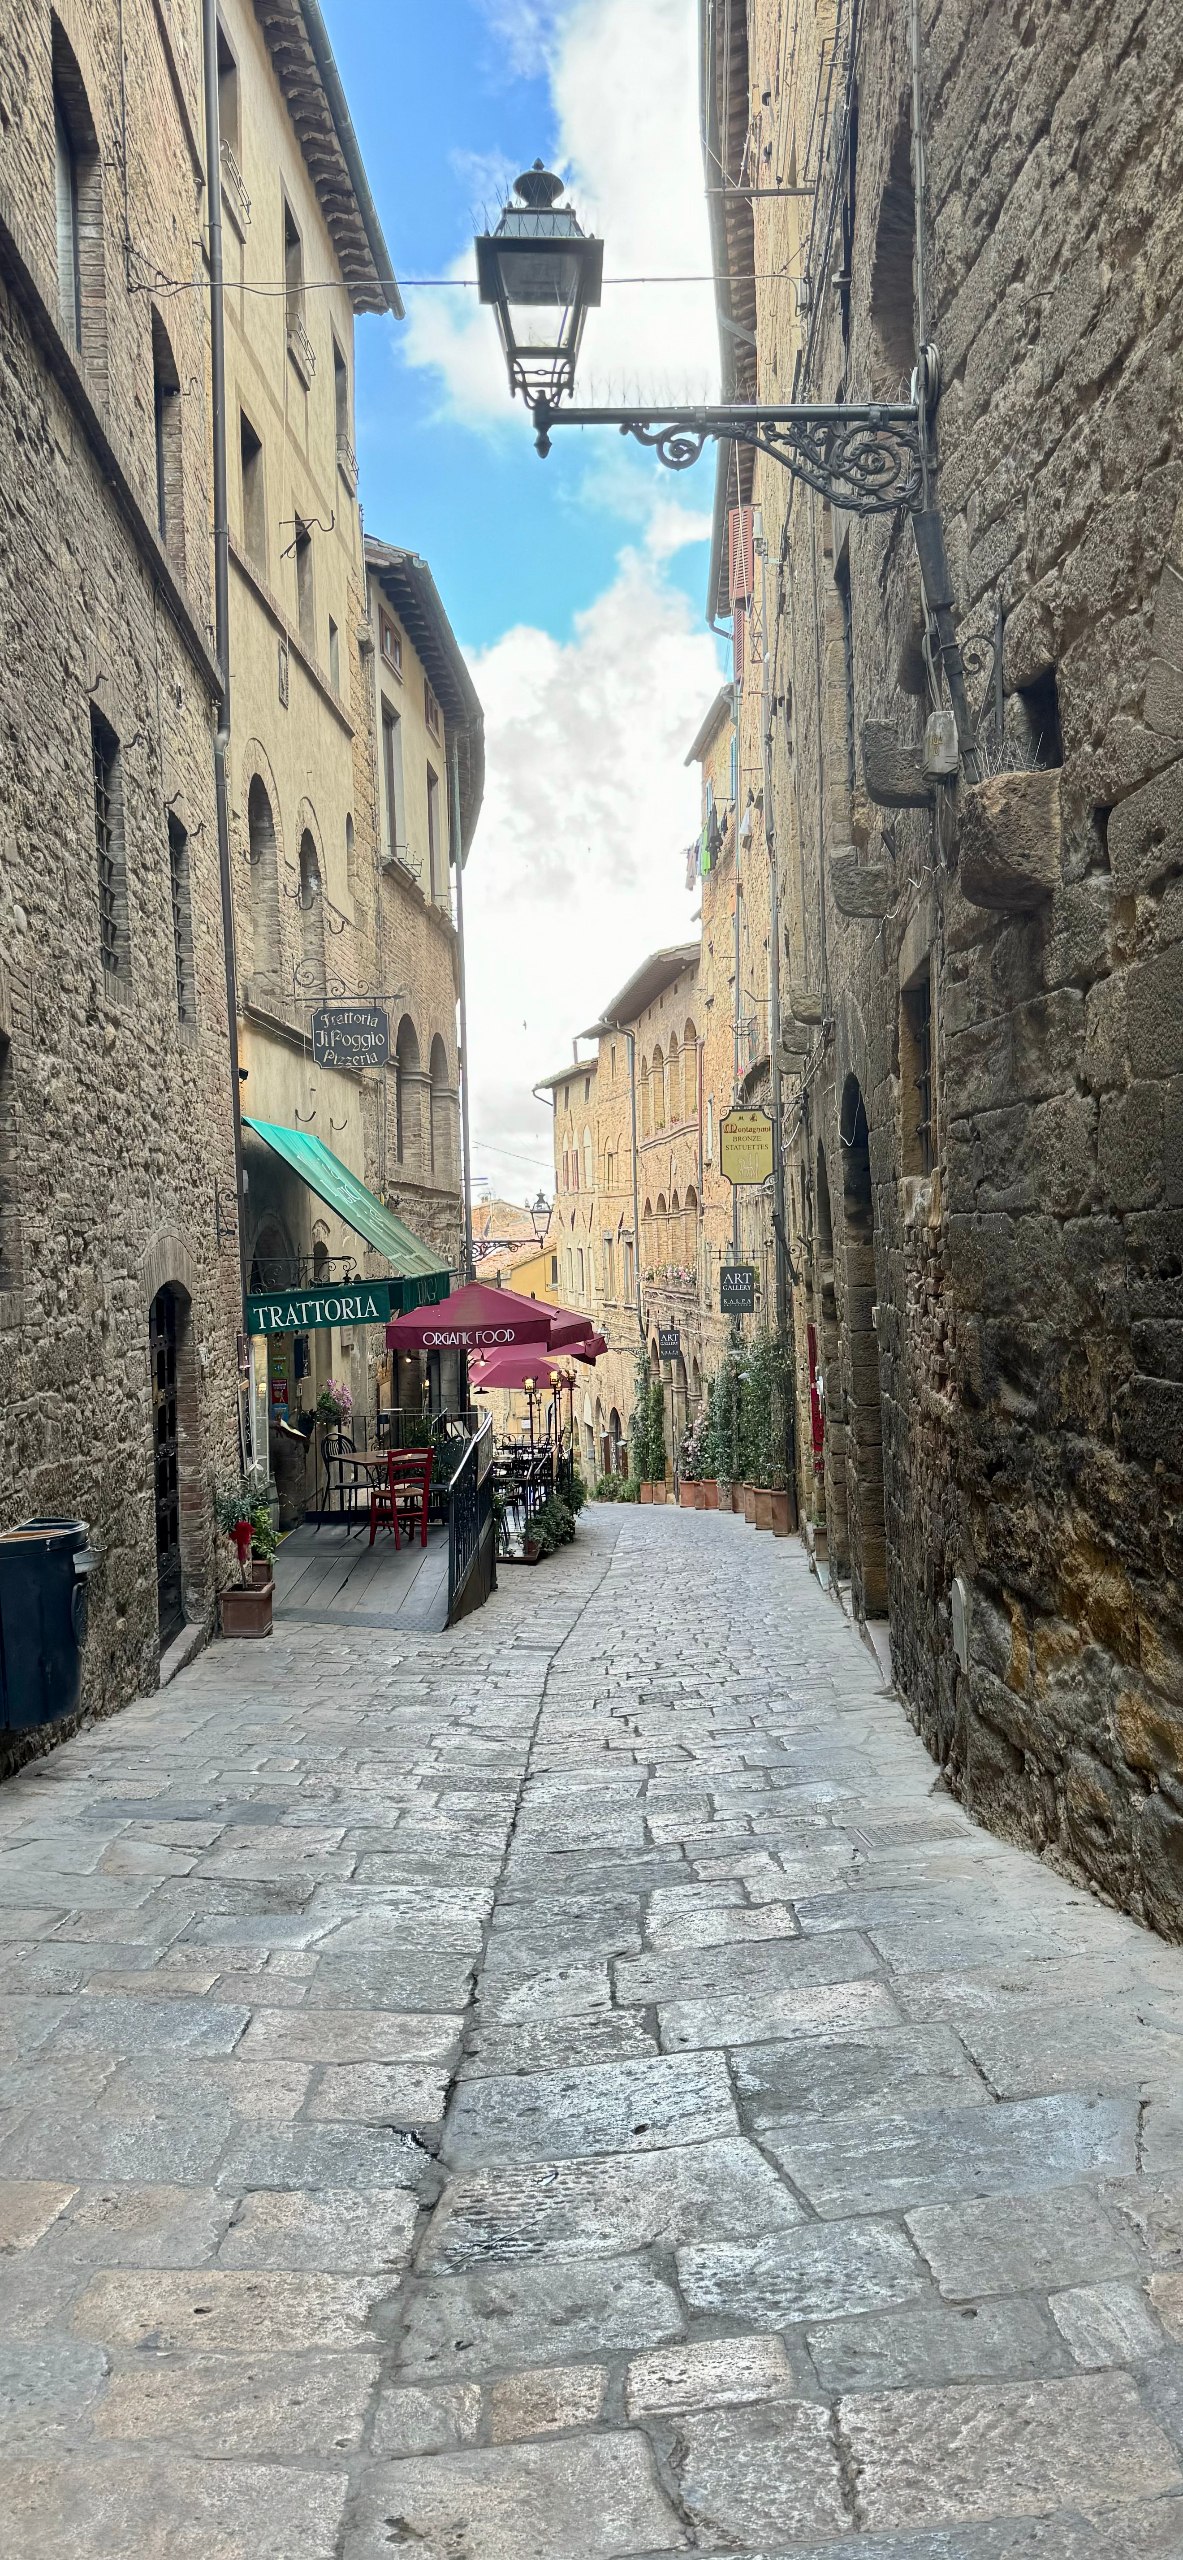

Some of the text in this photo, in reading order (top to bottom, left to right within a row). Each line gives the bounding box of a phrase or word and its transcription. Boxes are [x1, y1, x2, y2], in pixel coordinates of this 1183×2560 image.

[320, 1012, 378, 1028] Trattoria
[330, 1029, 385, 1051] Poggio
[323, 1049, 379, 1066] Pizzeria
[722, 1272, 752, 1284] ART
[253, 1296, 379, 1330] TRATTORIA
[422, 1329, 515, 1346] ORGANIC FOOD
[660, 1333, 679, 1342] ART
